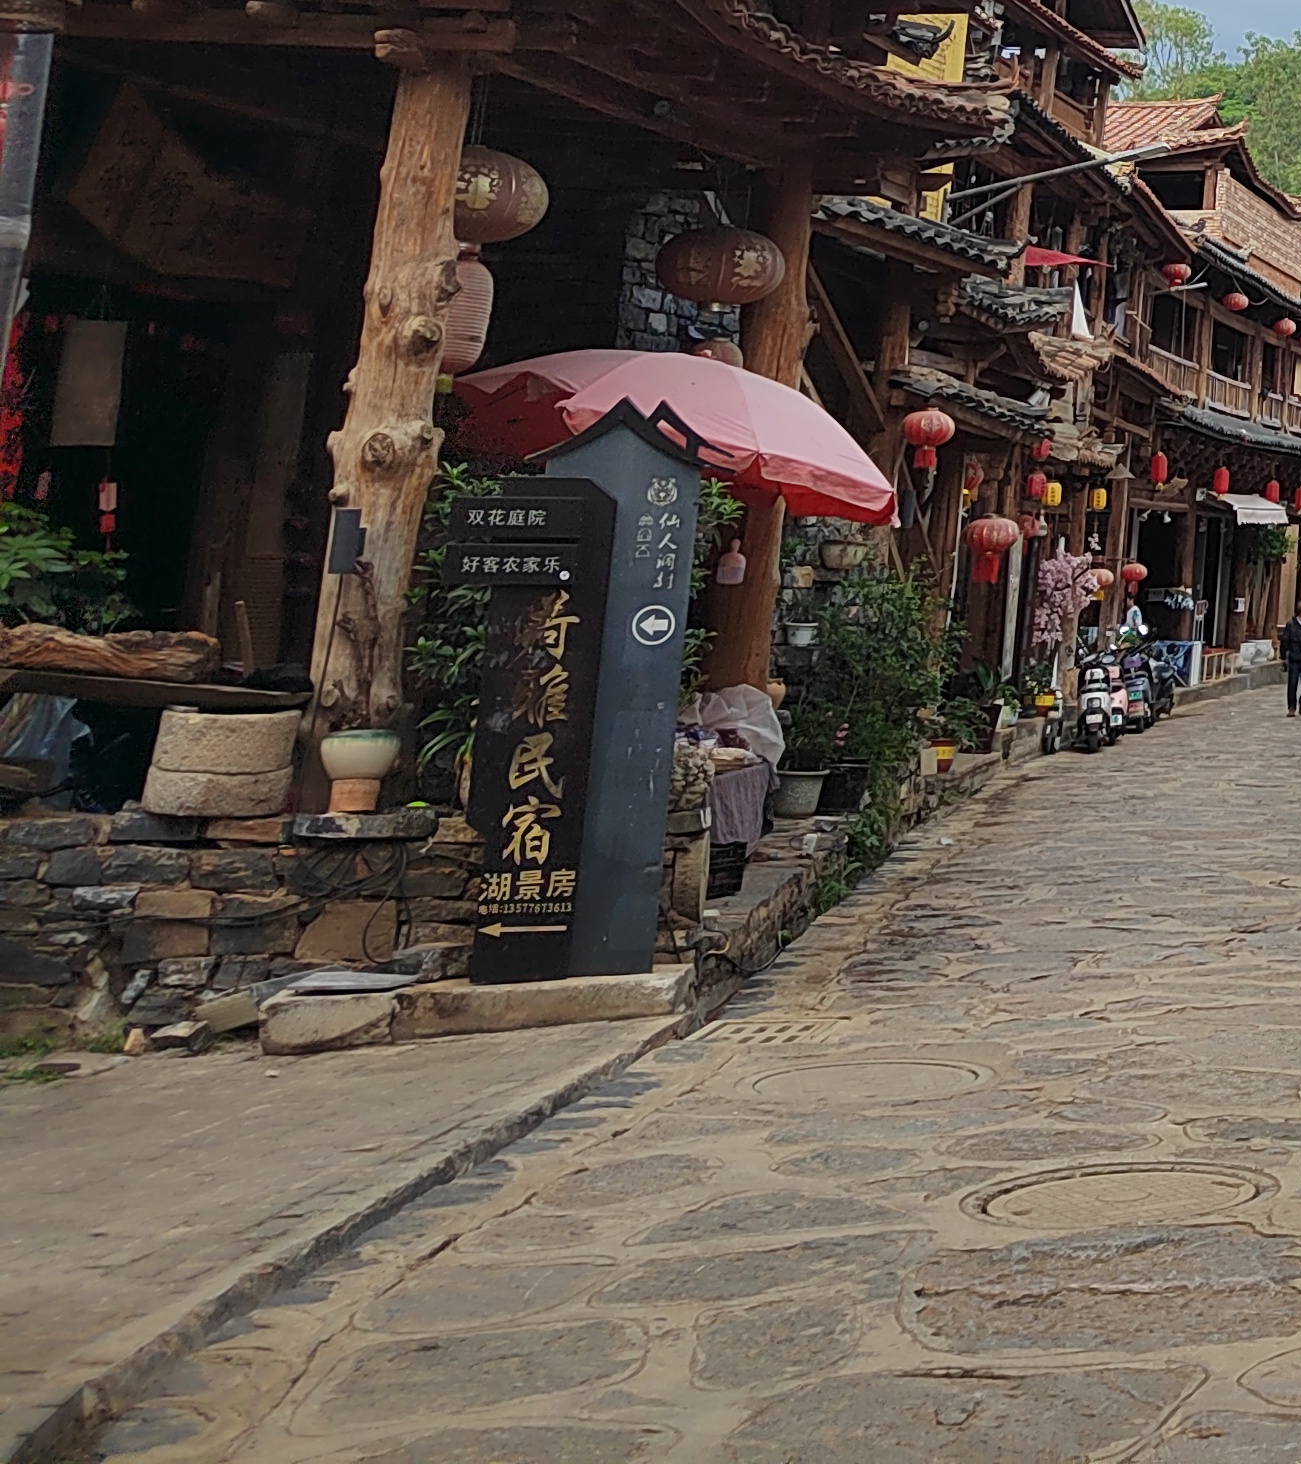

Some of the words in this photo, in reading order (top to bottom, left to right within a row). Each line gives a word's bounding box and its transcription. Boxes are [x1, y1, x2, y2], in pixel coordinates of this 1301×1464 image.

[467, 508, 547, 526] 双花庭院
[460, 556, 560, 574] 好客农家乐
[477, 868, 577, 902] 湖景房
